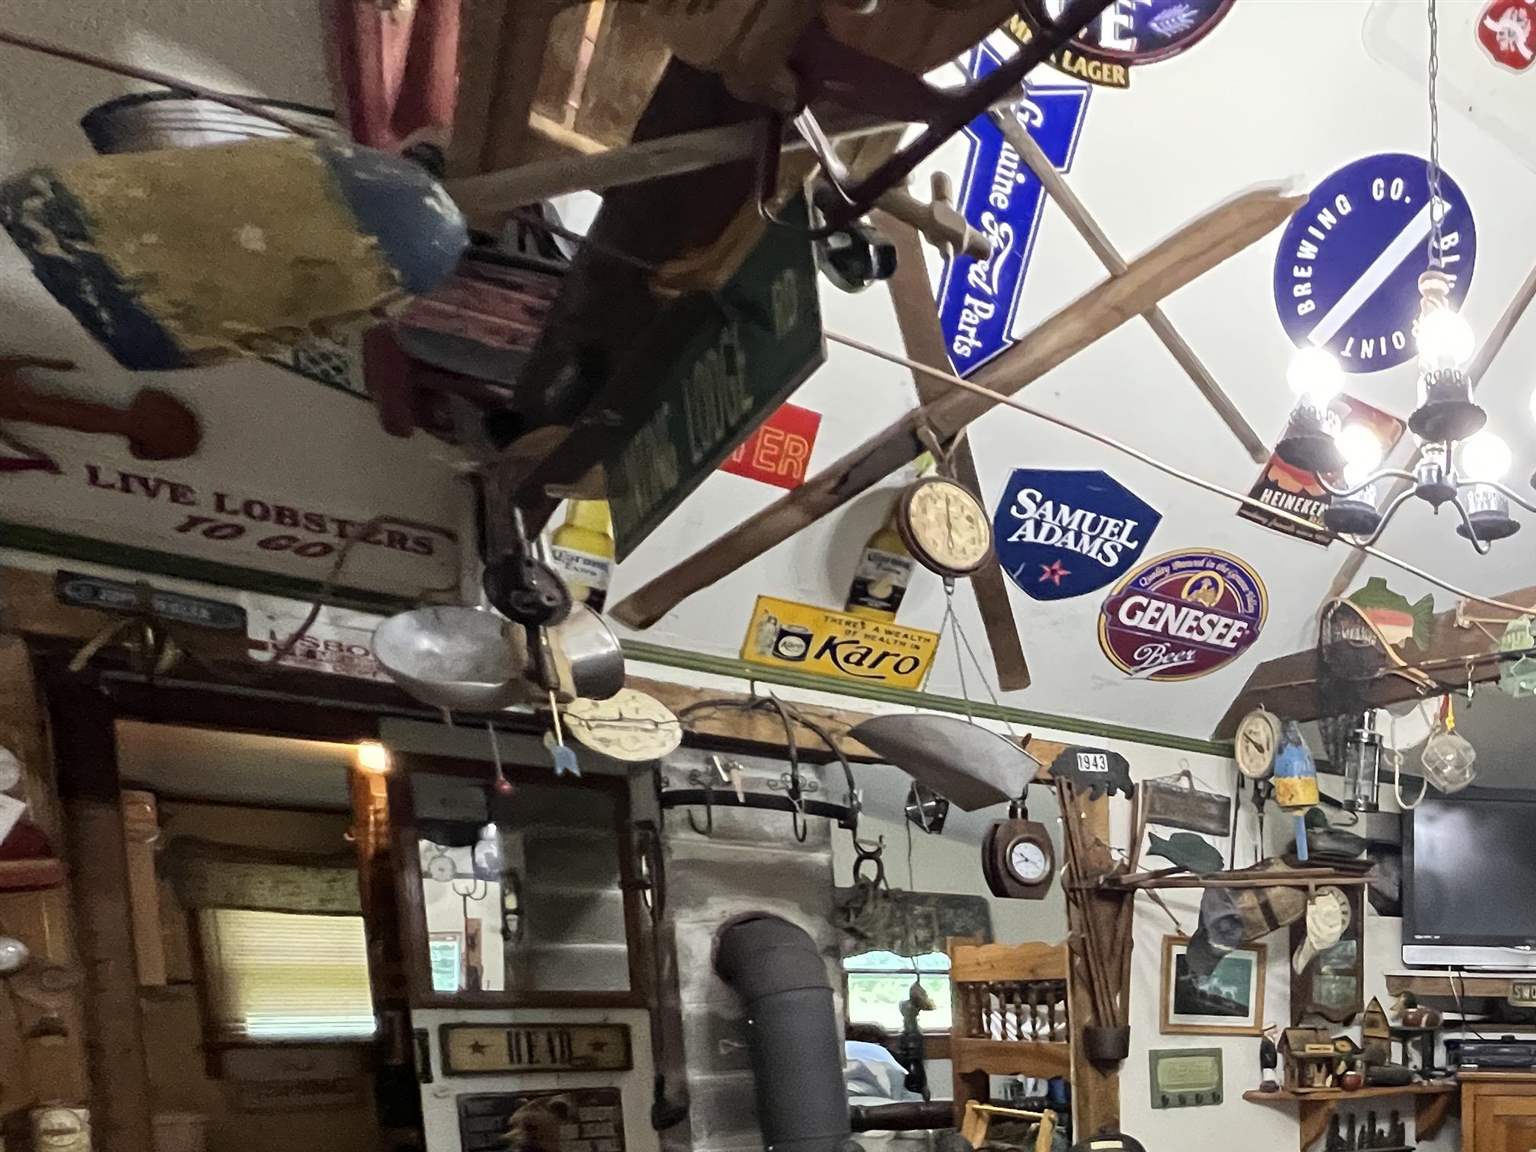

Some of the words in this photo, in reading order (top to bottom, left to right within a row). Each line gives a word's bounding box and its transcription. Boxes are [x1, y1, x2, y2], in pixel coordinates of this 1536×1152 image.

[1062, 49, 1126, 84] LAGER
[988, 98, 1044, 211] Guine
[1292, 193, 1352, 316] BREWING
[1372, 177, 1412, 204] CO.
[952, 293, 996, 359] Parts
[85, 464, 197, 506] LIVE
[212, 491, 435, 556] LOBSTERS
[1010, 488, 1139, 550] SAMUEL
[175, 515, 247, 540] TO
[256, 533, 337, 559] GO
[1007, 518, 1123, 568] ADAMS
[863, 633, 907, 648] HEALTH
[884, 627, 932, 644] WEALTH
[1118, 595, 1248, 649] GENESEE
[813, 635, 920, 680] Karo
[1132, 642, 1198, 668] Beer
[1077, 754, 1107, 771] 1943
